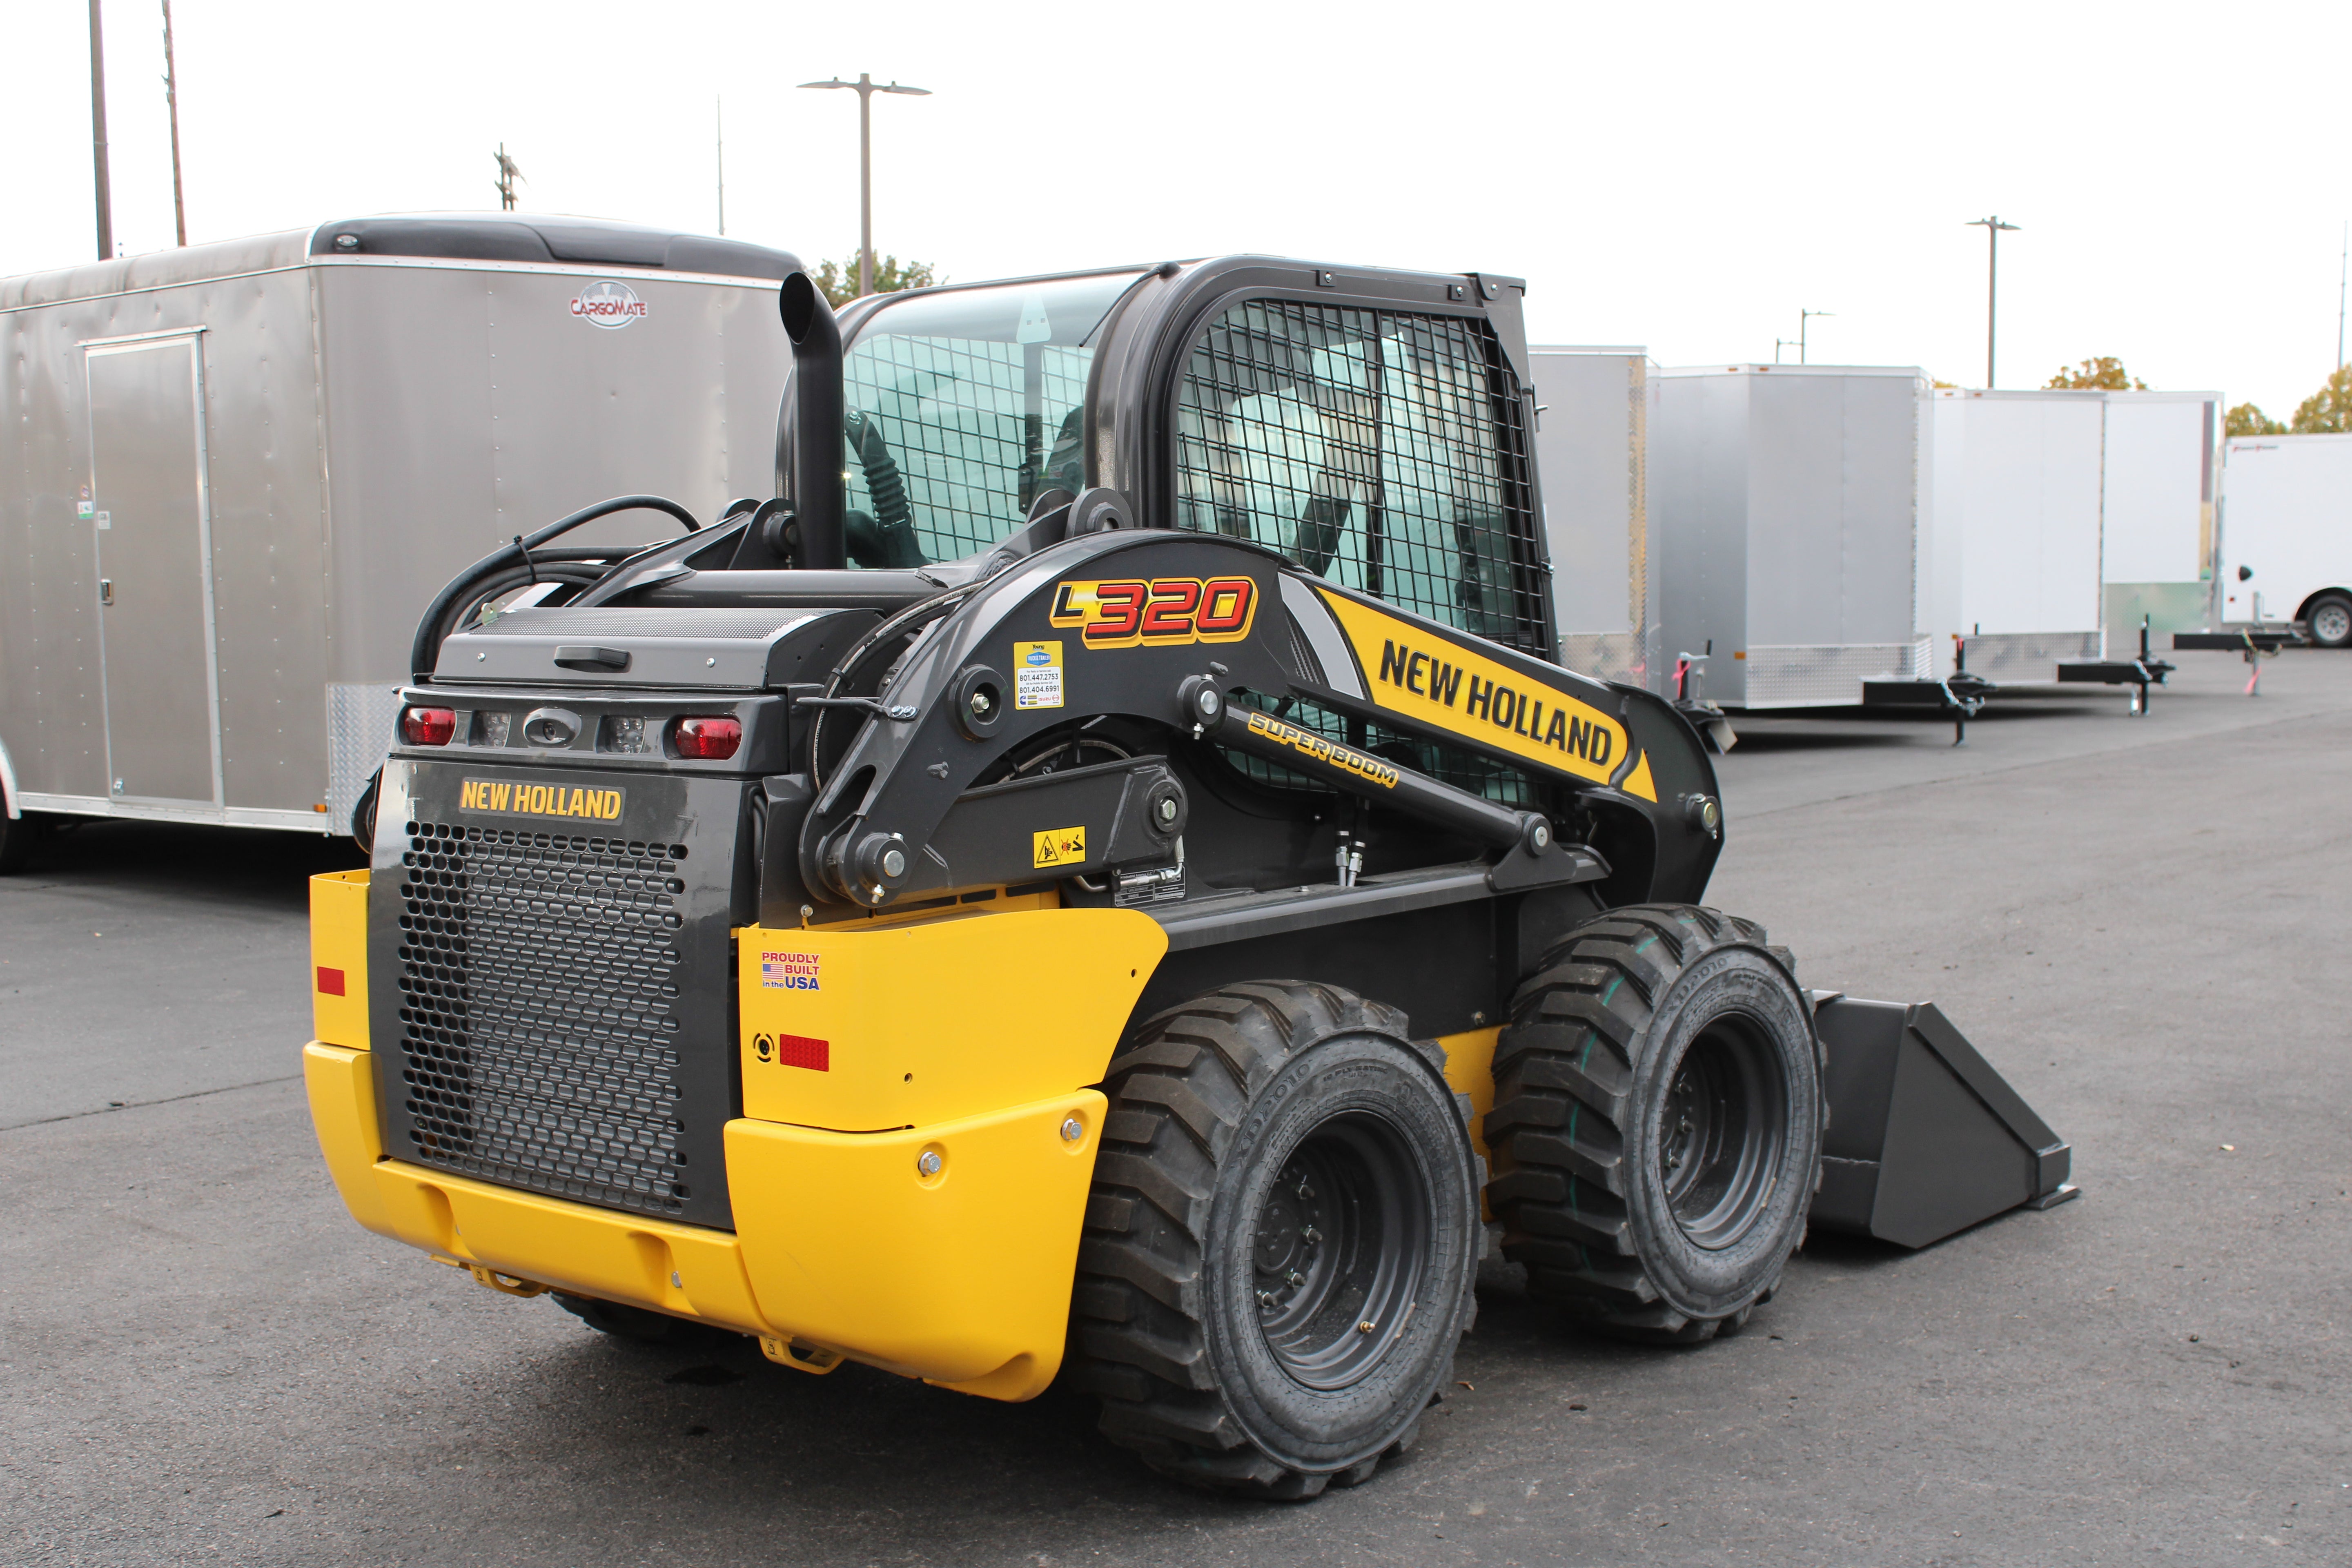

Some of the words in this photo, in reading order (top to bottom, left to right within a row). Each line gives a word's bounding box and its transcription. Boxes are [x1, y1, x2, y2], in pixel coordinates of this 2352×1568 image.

[1051, 577, 1257, 644] L320
[1020, 685, 1059, 693] 801.404.6991
[1379, 638, 1463, 708] NEW
[1466, 674, 1612, 767] HOLLAND
[461, 781, 511, 811] NEW
[513, 784, 621, 820] HOLLAND
[762, 952, 819, 964] PROUDLY
[785, 964, 820, 975] BUILT
[785, 976, 820, 990] USA
[1236, 1063, 1310, 1167] XD2010
